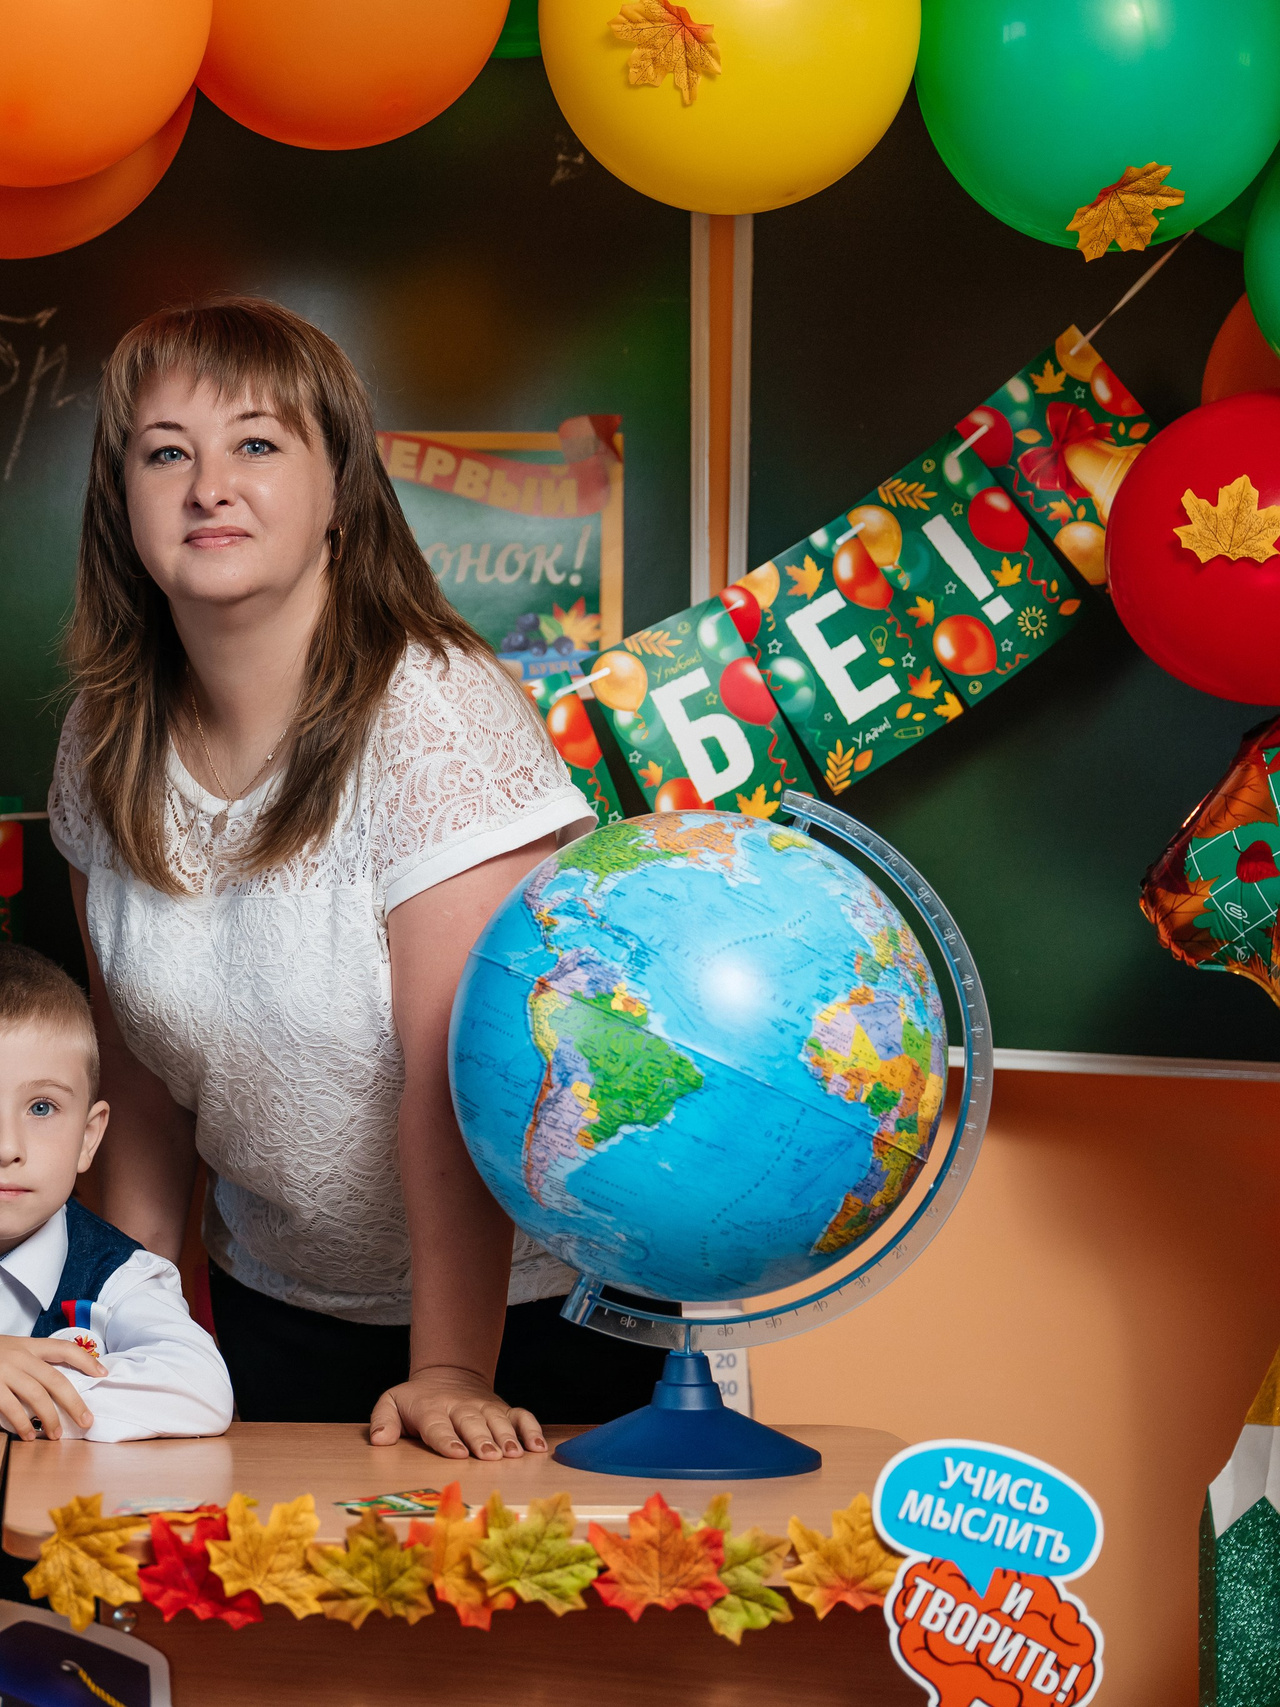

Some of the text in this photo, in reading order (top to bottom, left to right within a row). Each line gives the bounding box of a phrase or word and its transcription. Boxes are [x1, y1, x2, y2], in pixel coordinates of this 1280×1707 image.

[376, 435, 579, 517] ЕРВЫЙ
[917, 885, 933, 904] 60
[943, 927, 958, 946] 50
[716, 1325, 735, 1337] 60
[715, 1353, 737, 1369] 20
[939, 1456, 1050, 1516] УЧИСЬ
[897, 1489, 1071, 1564] МЫСЛИТЬ
[1000, 1581, 1035, 1621] И
[903, 1576, 1082, 1704] ТВОРИТЬ!
